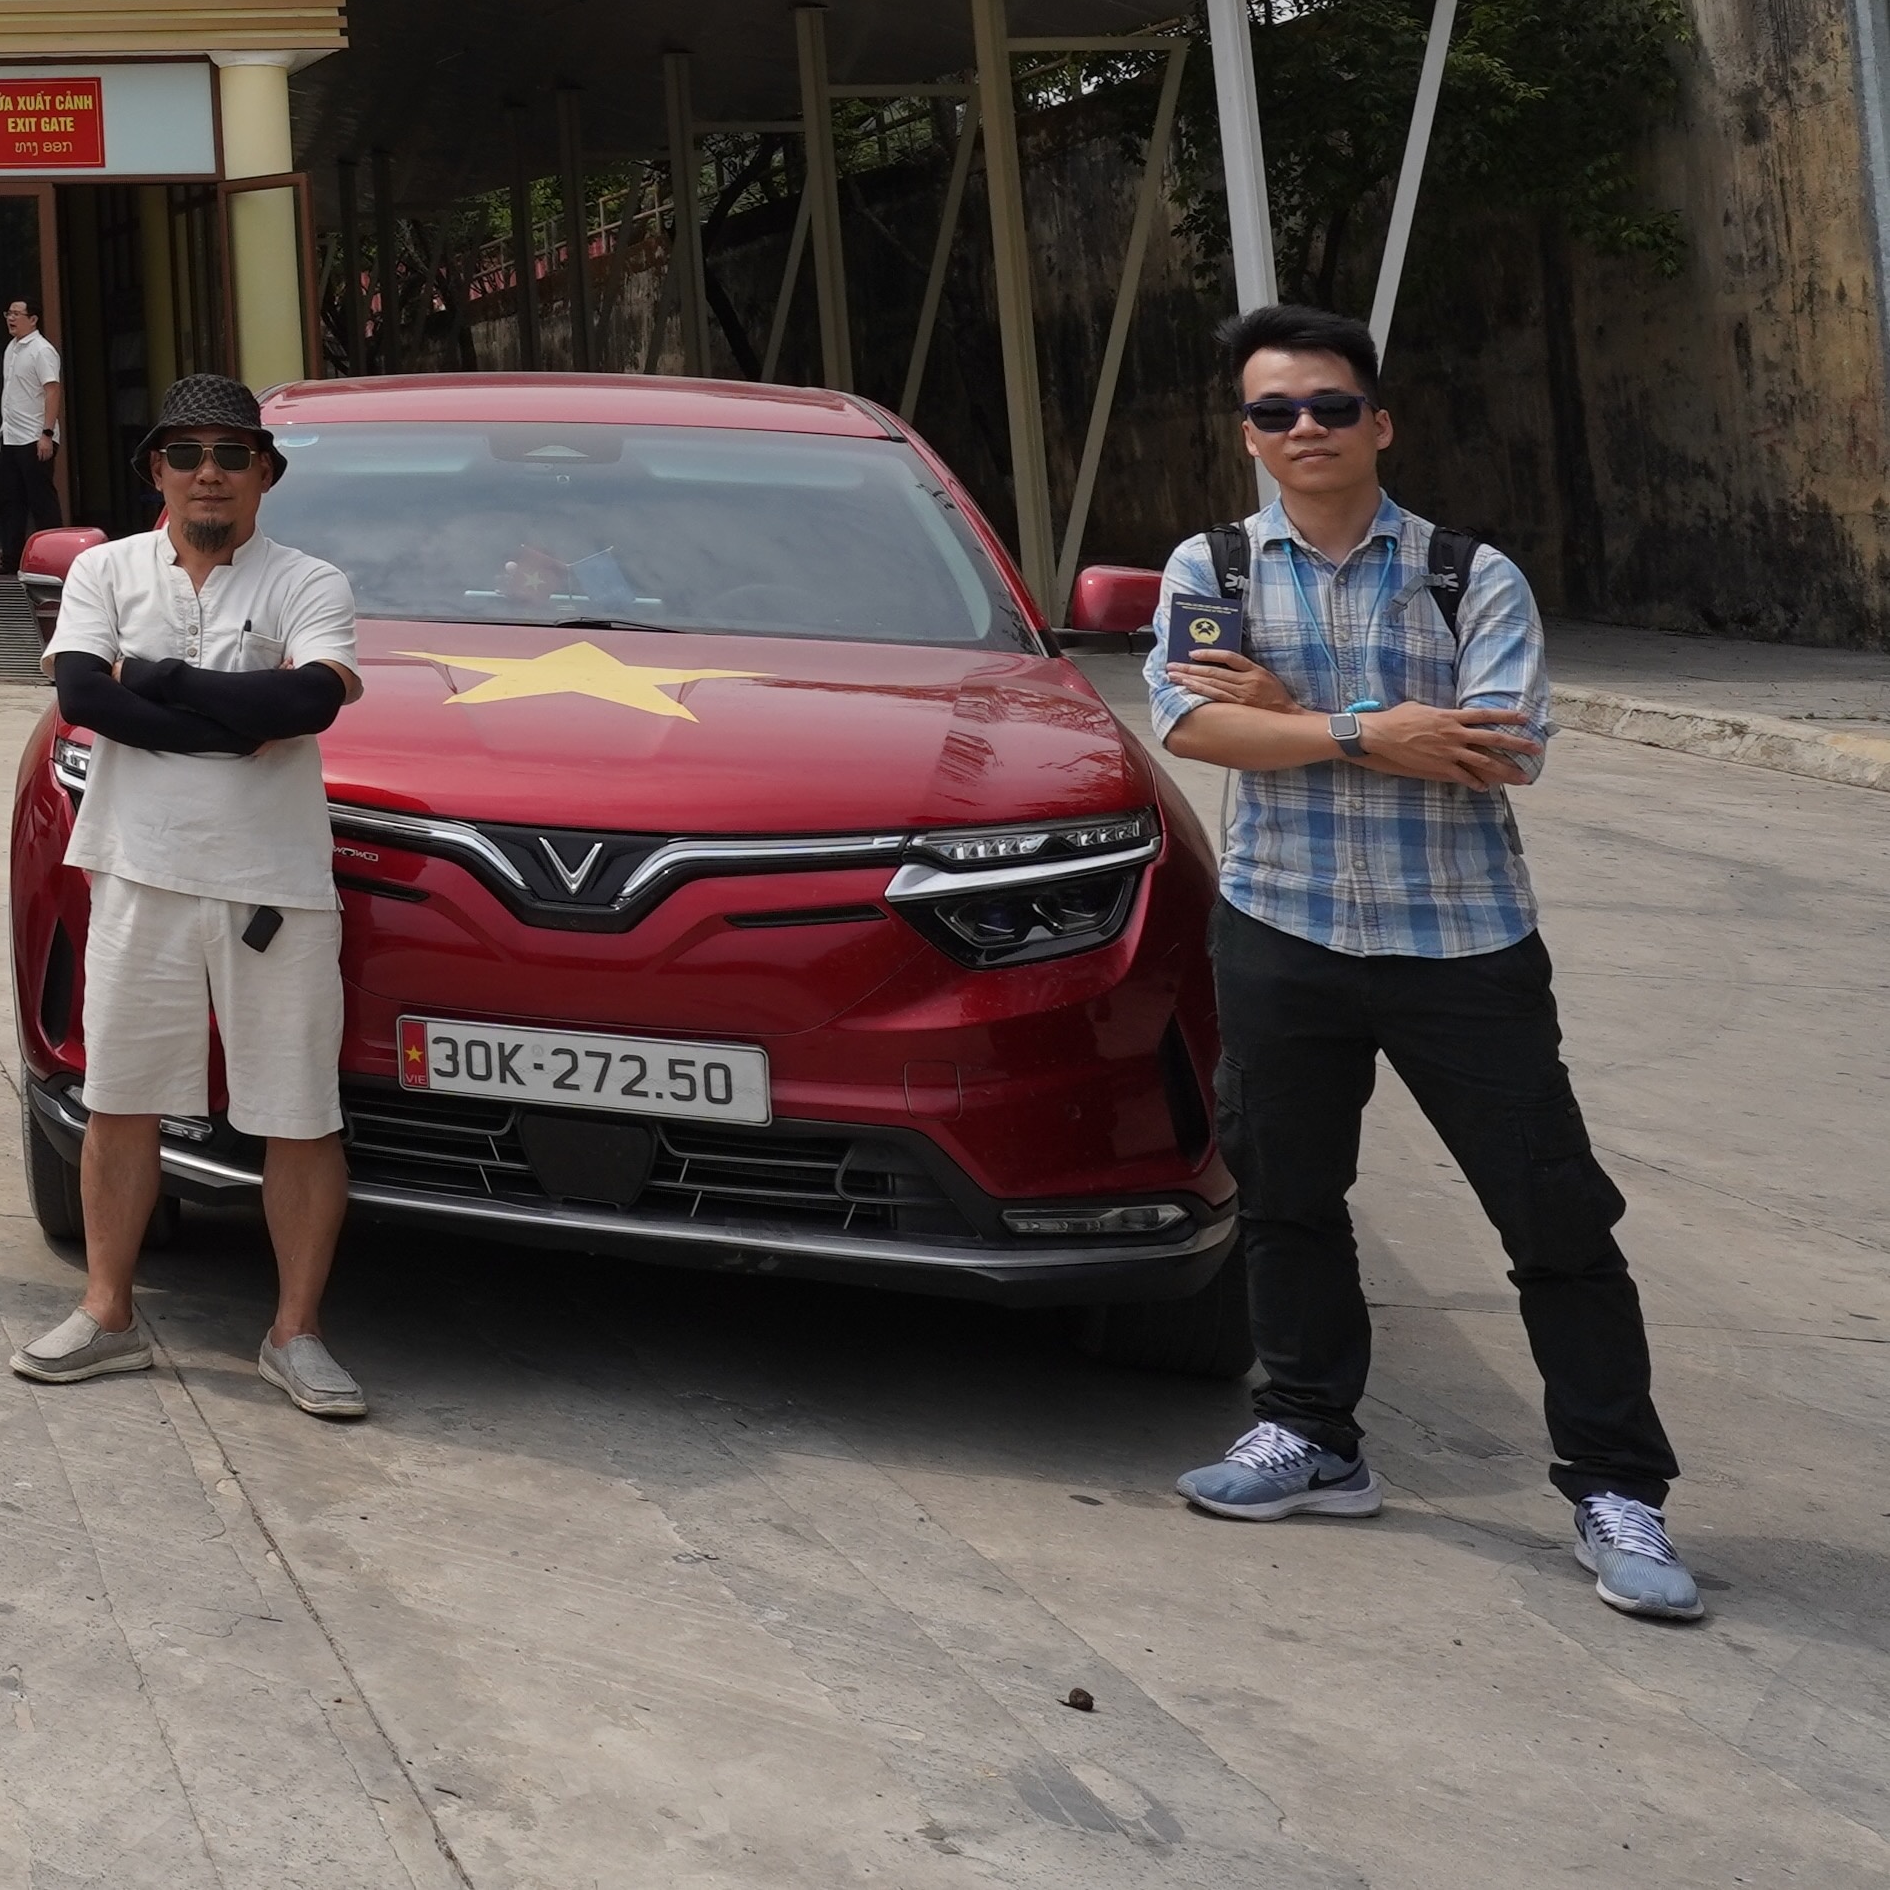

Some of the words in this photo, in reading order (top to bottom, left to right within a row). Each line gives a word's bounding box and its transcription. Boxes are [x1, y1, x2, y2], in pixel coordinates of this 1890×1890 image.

[17, 90, 51, 110] XUẤT
[55, 91, 93, 110] CẢNH
[8, 118, 37, 132] EXIT
[41, 117, 75, 132] GATE
[432, 1036, 733, 1105] 30K-272.50
[406, 1074, 426, 1085] VIE
